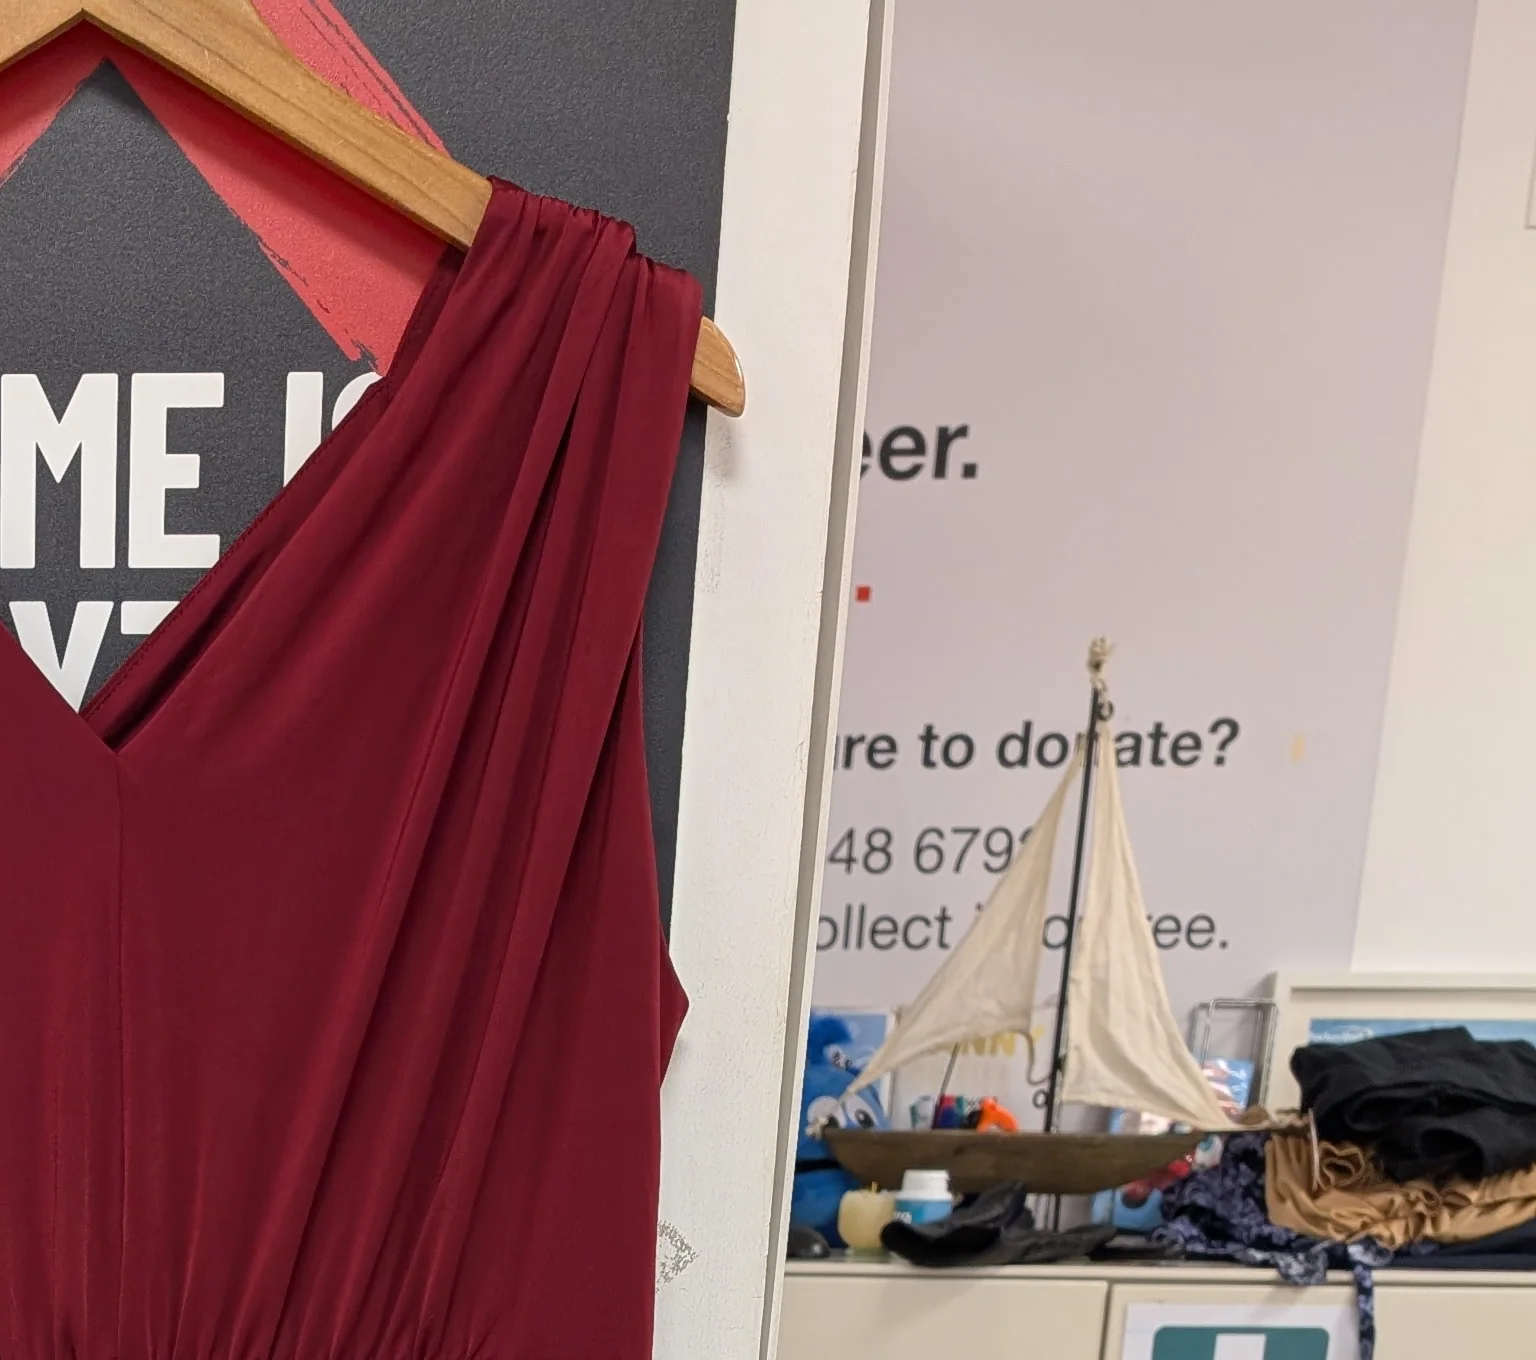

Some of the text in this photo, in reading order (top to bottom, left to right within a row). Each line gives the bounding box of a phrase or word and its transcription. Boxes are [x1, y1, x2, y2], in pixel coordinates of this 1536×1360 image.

[860, 423, 978, 480] er.
[833, 731, 897, 770] re
[918, 724, 974, 769] to
[827, 826, 1034, 874] 48 679
